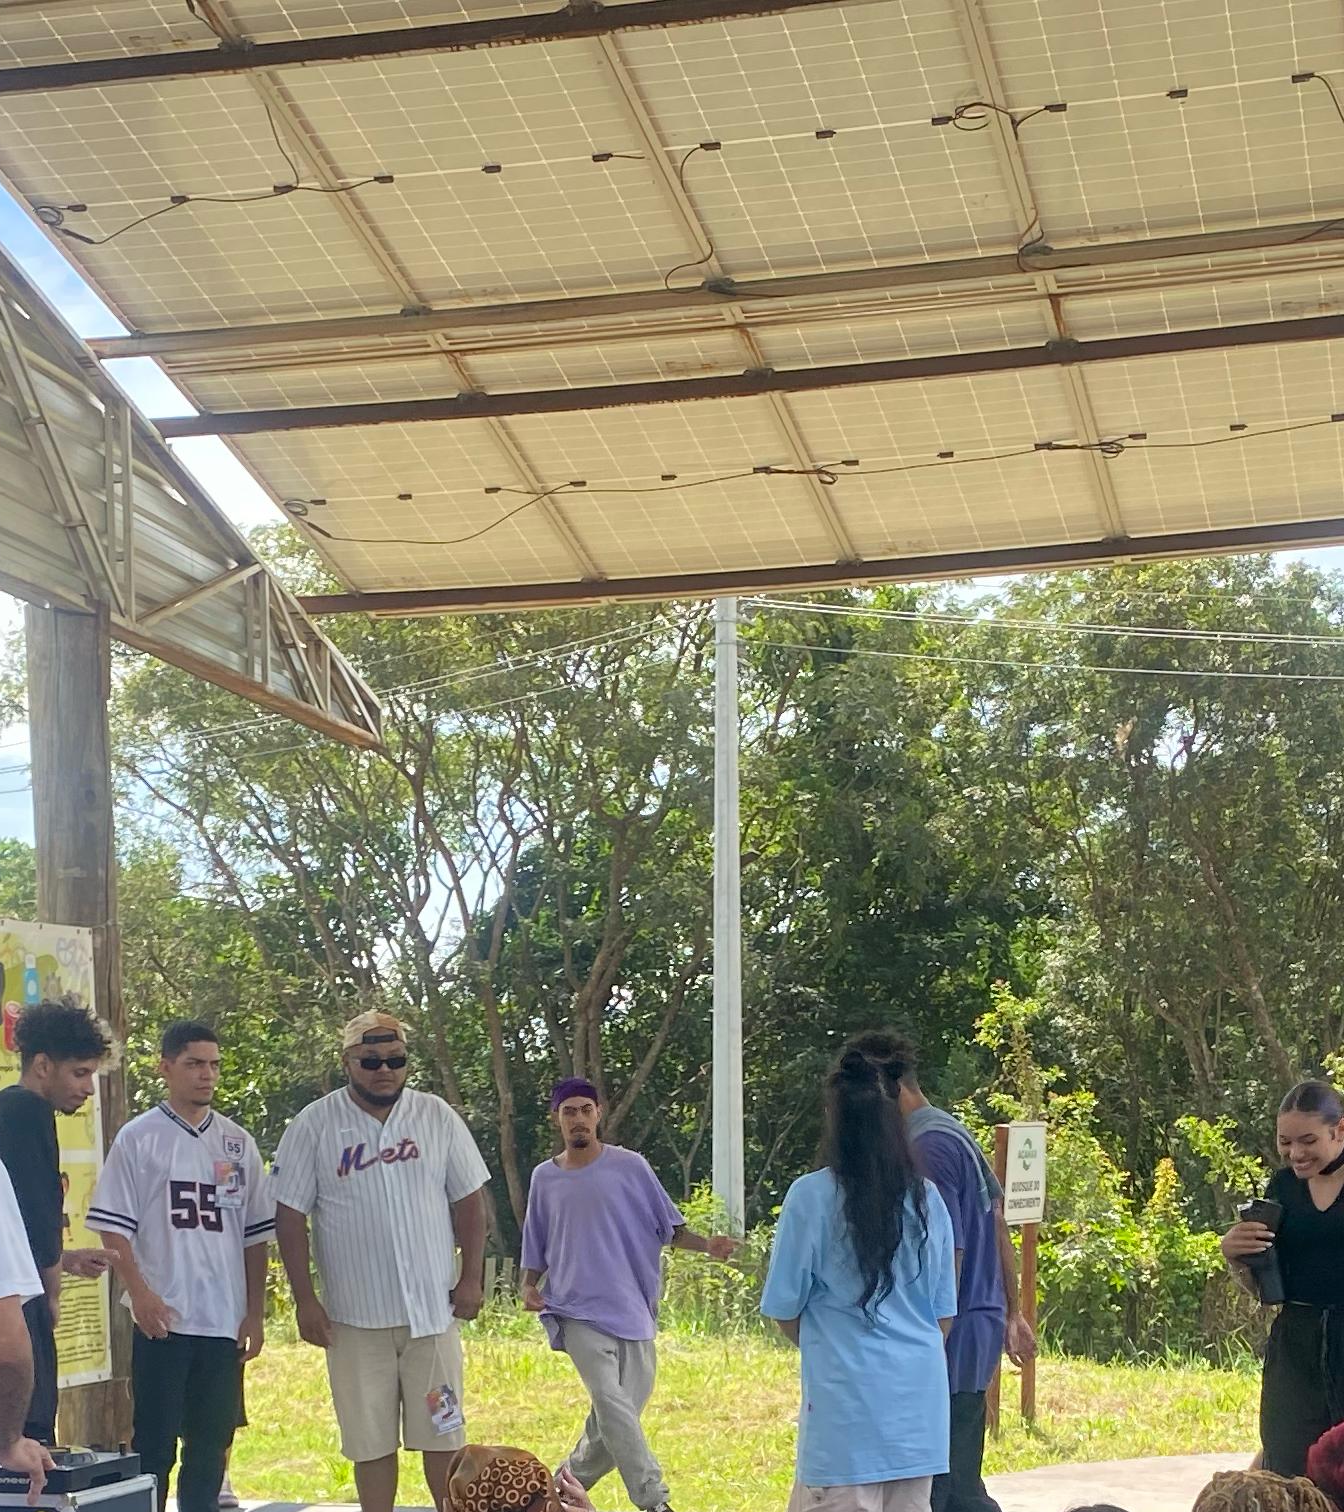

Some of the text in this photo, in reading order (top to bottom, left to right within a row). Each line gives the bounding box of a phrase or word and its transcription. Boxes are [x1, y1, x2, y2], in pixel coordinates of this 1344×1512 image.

[227, 1142, 241, 1154] 55
[337, 1137, 420, 1178] Mets
[168, 1180, 224, 1233] 55
